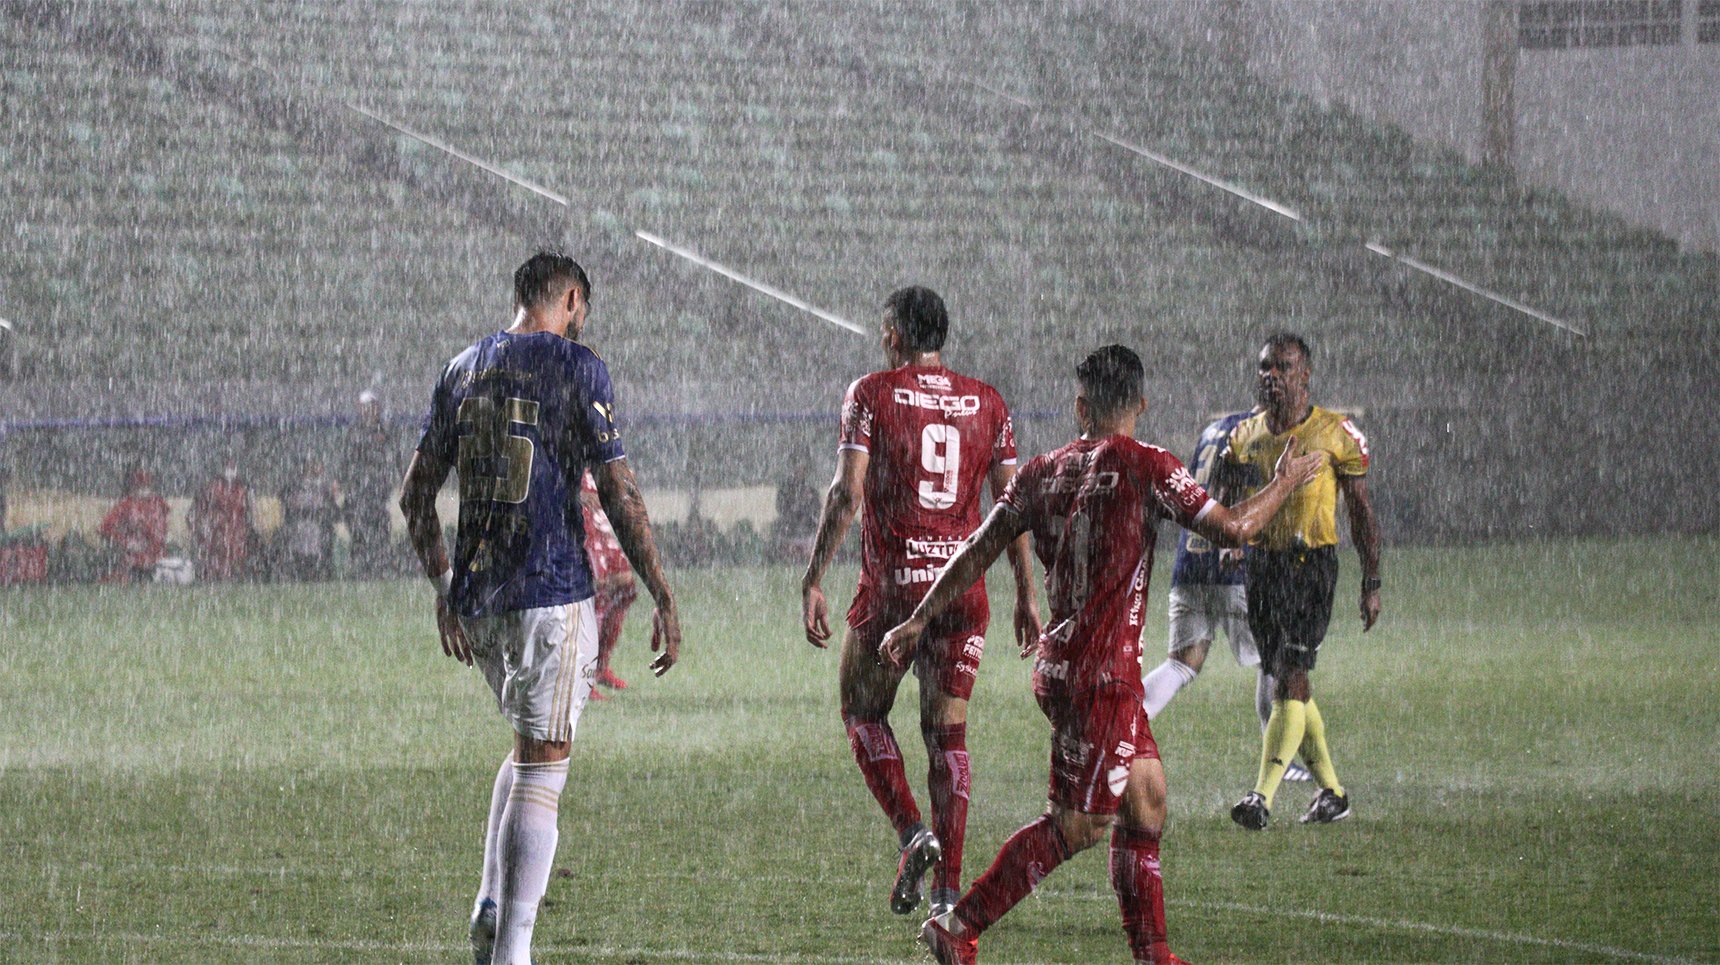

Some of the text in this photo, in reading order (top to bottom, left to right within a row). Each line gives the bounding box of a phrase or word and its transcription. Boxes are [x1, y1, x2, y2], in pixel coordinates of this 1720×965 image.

[894, 388, 980, 411] DIEGO
[917, 373, 951, 387] MEGA
[456, 396, 540, 504] 25
[918, 423, 961, 509] 9
